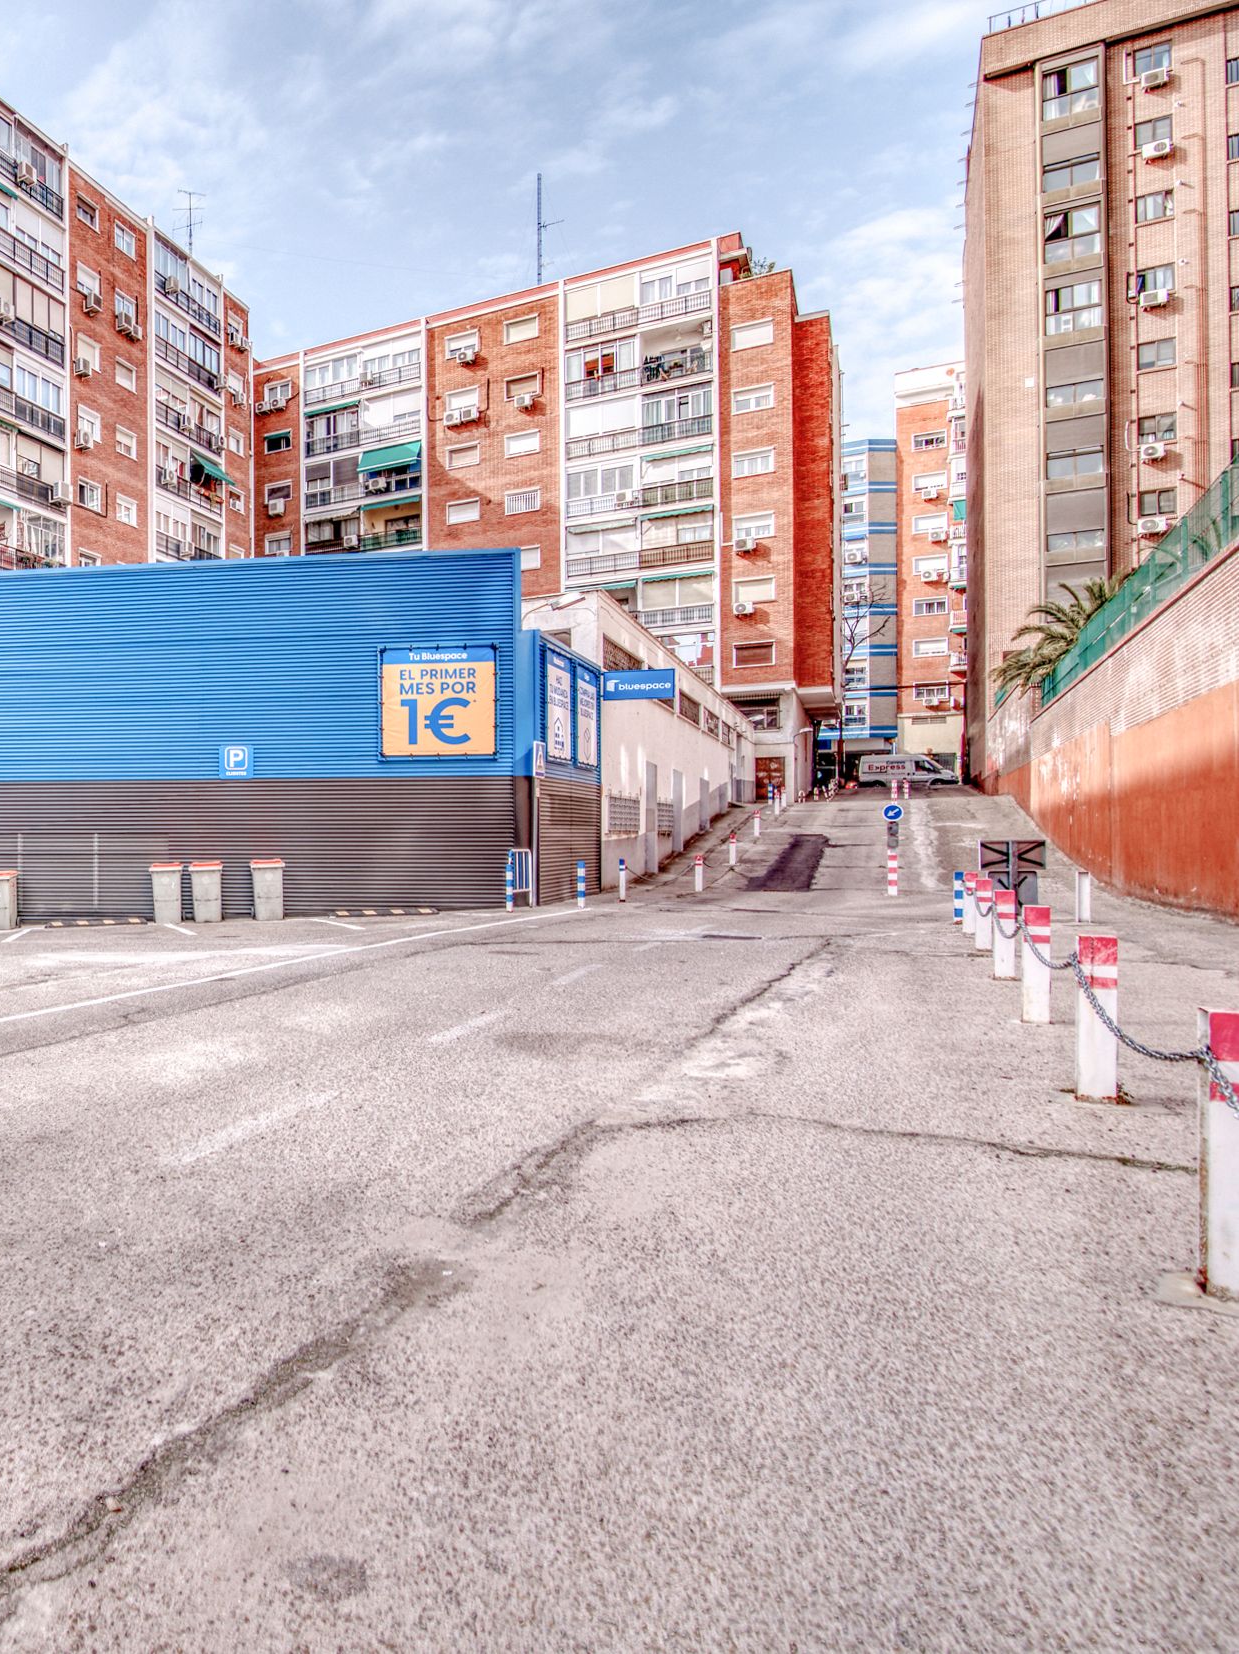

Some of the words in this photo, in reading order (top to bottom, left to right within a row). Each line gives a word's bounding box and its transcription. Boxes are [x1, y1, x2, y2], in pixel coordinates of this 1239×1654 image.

[409, 652, 420, 661] Tu
[421, 652, 468, 662] Bluespace
[399, 669, 415, 681] EL
[420, 668, 476, 680] PRIMER
[399, 683, 435, 695] MES
[440, 681, 476, 695] POR
[618, 681, 671, 691] bluespace
[229, 749, 244, 768] P
